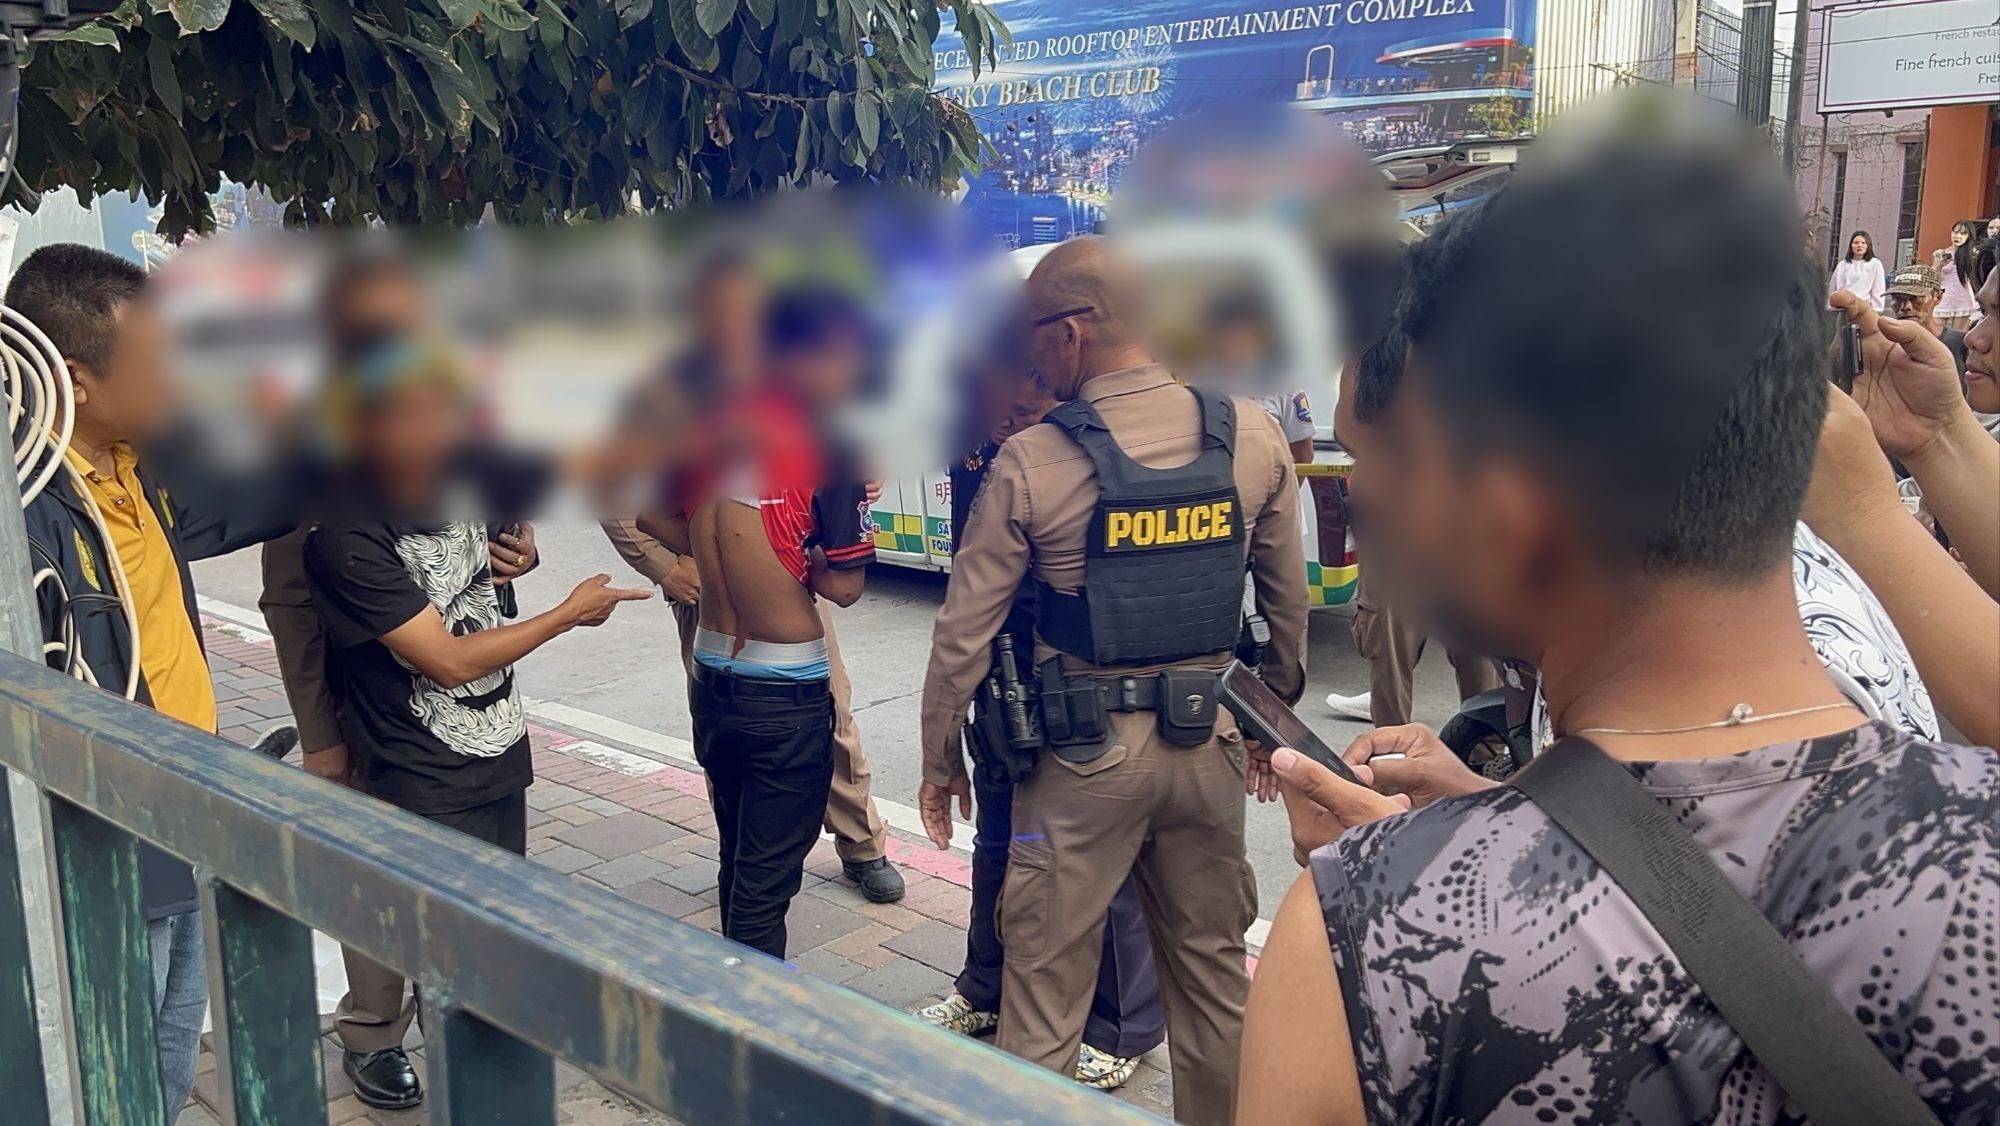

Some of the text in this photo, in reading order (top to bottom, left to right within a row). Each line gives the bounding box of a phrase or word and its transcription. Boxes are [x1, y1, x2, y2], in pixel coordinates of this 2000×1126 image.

[1045, 28, 1139, 58] ROOFTOP
[1145, 4, 1341, 47] ENTERTAINMENT
[1346, 0, 1475, 23] COMPLEX
[1935, 28, 1969, 40] French
[1895, 59, 1924, 71] Fine
[1928, 51, 1971, 68] french
[998, 74, 1083, 106] BEACH
[1090, 66, 1160, 98] CLUB
[1894, 273, 1922, 282] FENDI
[1107, 501, 1232, 548] POLICE
